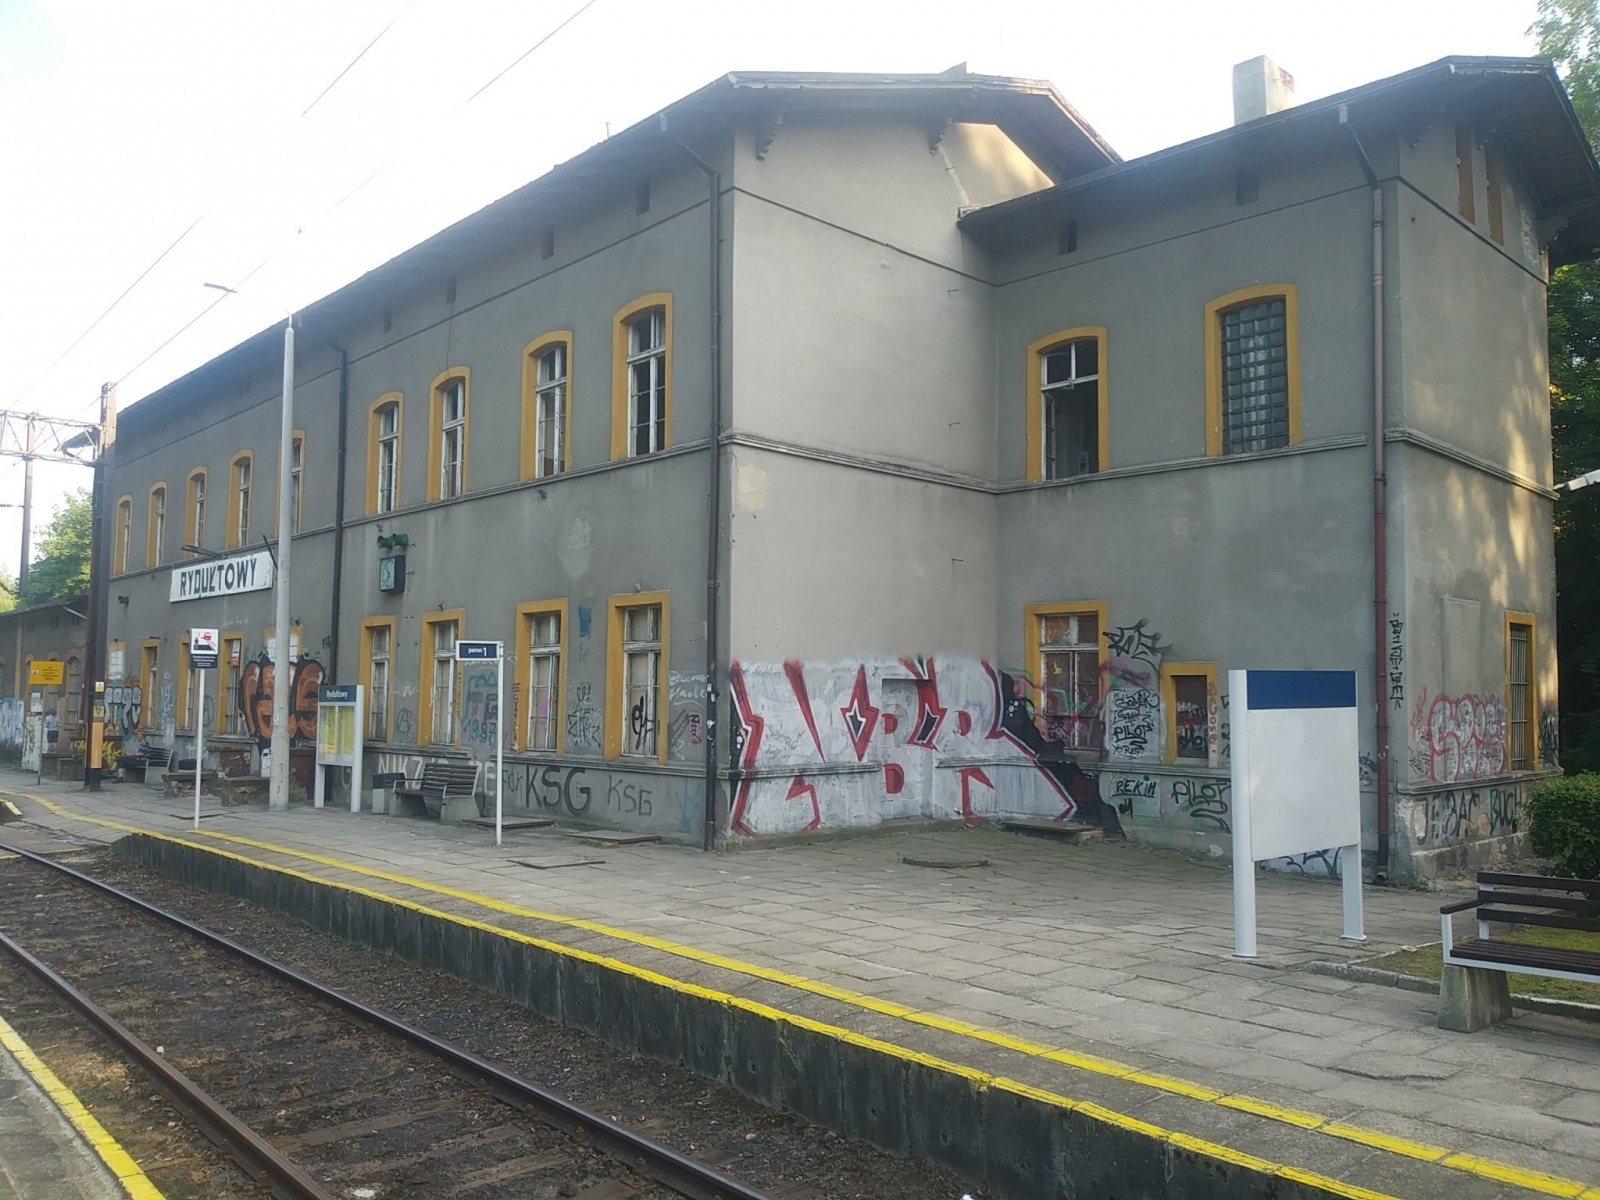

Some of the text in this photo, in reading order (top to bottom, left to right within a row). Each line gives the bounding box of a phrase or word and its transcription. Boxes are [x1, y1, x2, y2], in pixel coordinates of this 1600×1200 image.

[180, 558, 257, 597] RYDUŁTOWY
[467, 646, 487, 657] peron 1
[525, 764, 591, 816] KSG
[607, 773, 653, 817] KSG
